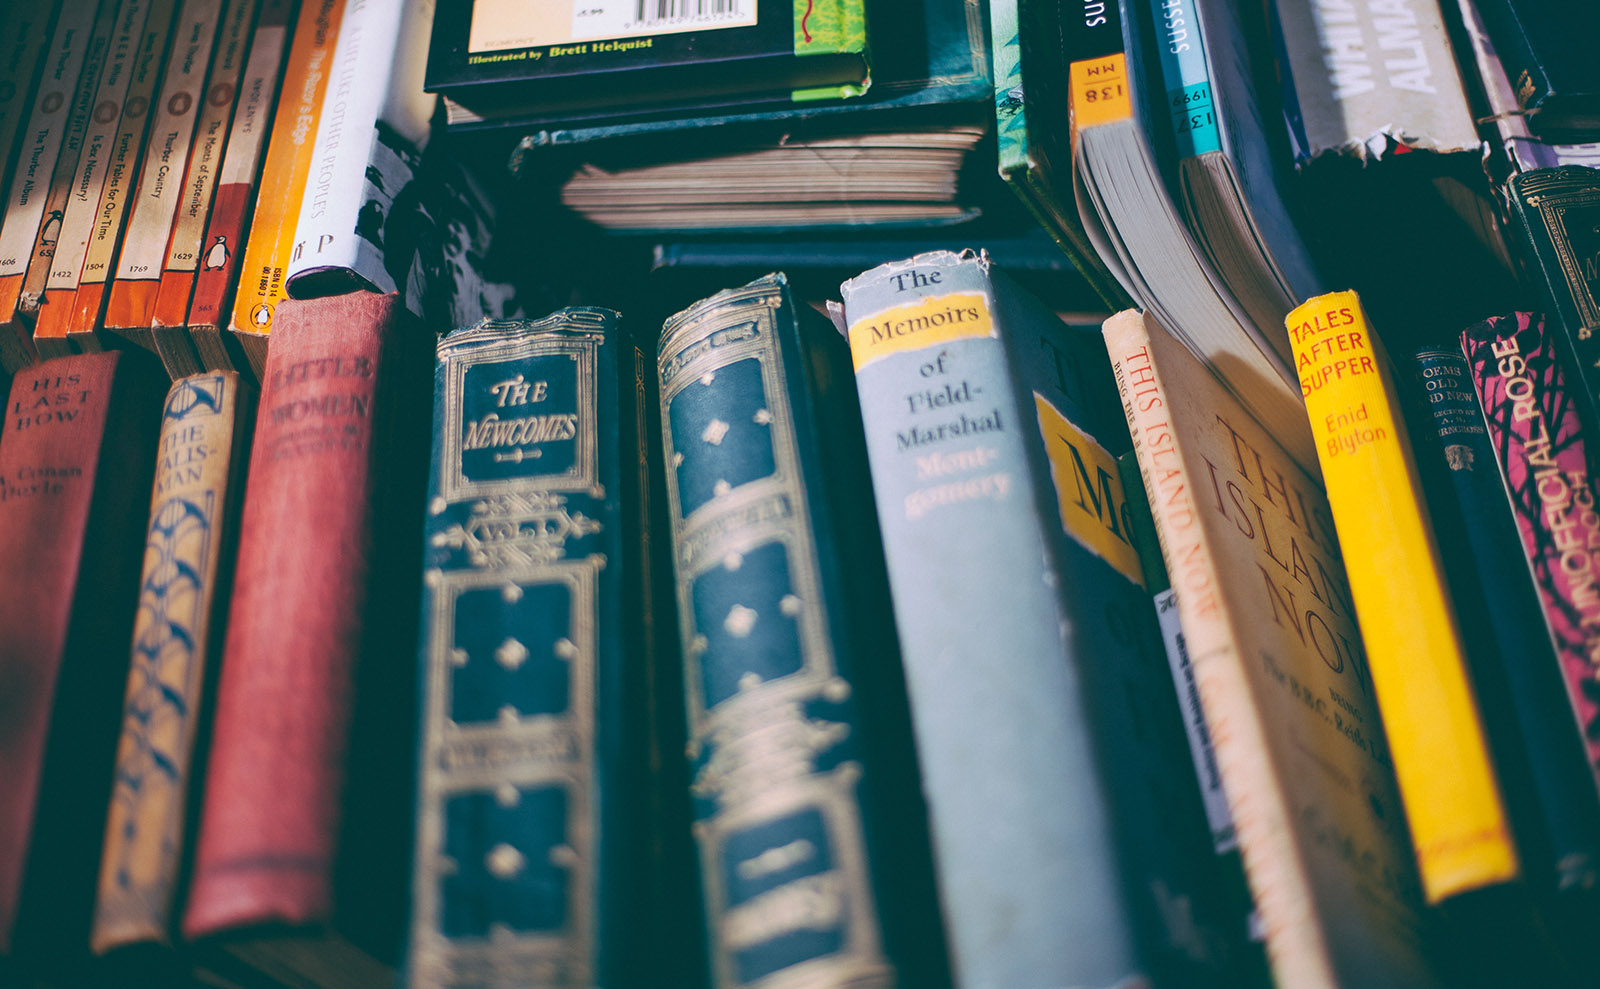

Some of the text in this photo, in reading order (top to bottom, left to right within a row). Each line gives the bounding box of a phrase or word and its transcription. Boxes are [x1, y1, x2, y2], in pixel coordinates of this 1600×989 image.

[1085, 0, 1107, 28] SU
[468, 38, 653, 65] Illustrated by Brett Helquist
[1087, 63, 1115, 77] MM
[1085, 83, 1122, 103] 138
[1172, 88, 1207, 106] 1999
[291, 114, 313, 145] Edge
[324, 102, 347, 154] OTHER
[1177, 112, 1212, 134] 137
[20, 128, 49, 206] The Thurber Album
[76, 135, 104, 202] Is Sex Necessary?
[150, 131, 178, 199] Thurber Country
[189, 120, 221, 218] The Month of September
[98, 132, 133, 241] Further Fables for Our Time
[85, 263, 104, 271] 1504
[129, 265, 148, 273] 1769
[173, 252, 193, 261] 1629
[52, 270, 72, 279] 1422
[272, 267, 282, 282] ISBN
[890, 268, 943, 293] The
[269, 289, 278, 297] 14
[869, 305, 979, 347] Memoirs
[1290, 307, 1355, 345] TALES
[919, 350, 947, 379] of
[1298, 331, 1364, 373] AFTER
[33, 374, 82, 393] HIS
[1300, 356, 1375, 399] SUPPER
[1418, 365, 1461, 381] OEMS
[1425, 378, 1459, 391] OLD
[1491, 336, 1542, 422] ROSE
[14, 390, 92, 415] LAST
[490, 374, 548, 408] THE
[906, 383, 983, 415] Field-
[1114, 361, 1129, 398] BEING
[1124, 400, 1136, 426] THE
[1446, 389, 1473, 403] NEW
[16, 409, 80, 431] BOW
[464, 412, 578, 450] NEWCOMES
[896, 409, 1004, 452] Marshal
[1325, 402, 1369, 435] Enid
[163, 424, 206, 453] THE
[1125, 345, 1163, 412] THIS
[1145, 421, 1194, 530] ISLAND
[1326, 426, 1387, 459] Blyton
[915, 446, 998, 480] Mont-
[903, 473, 1010, 522] gomery
[1216, 414, 1339, 562] THIS
[1201, 454, 1357, 628] ISLAN
